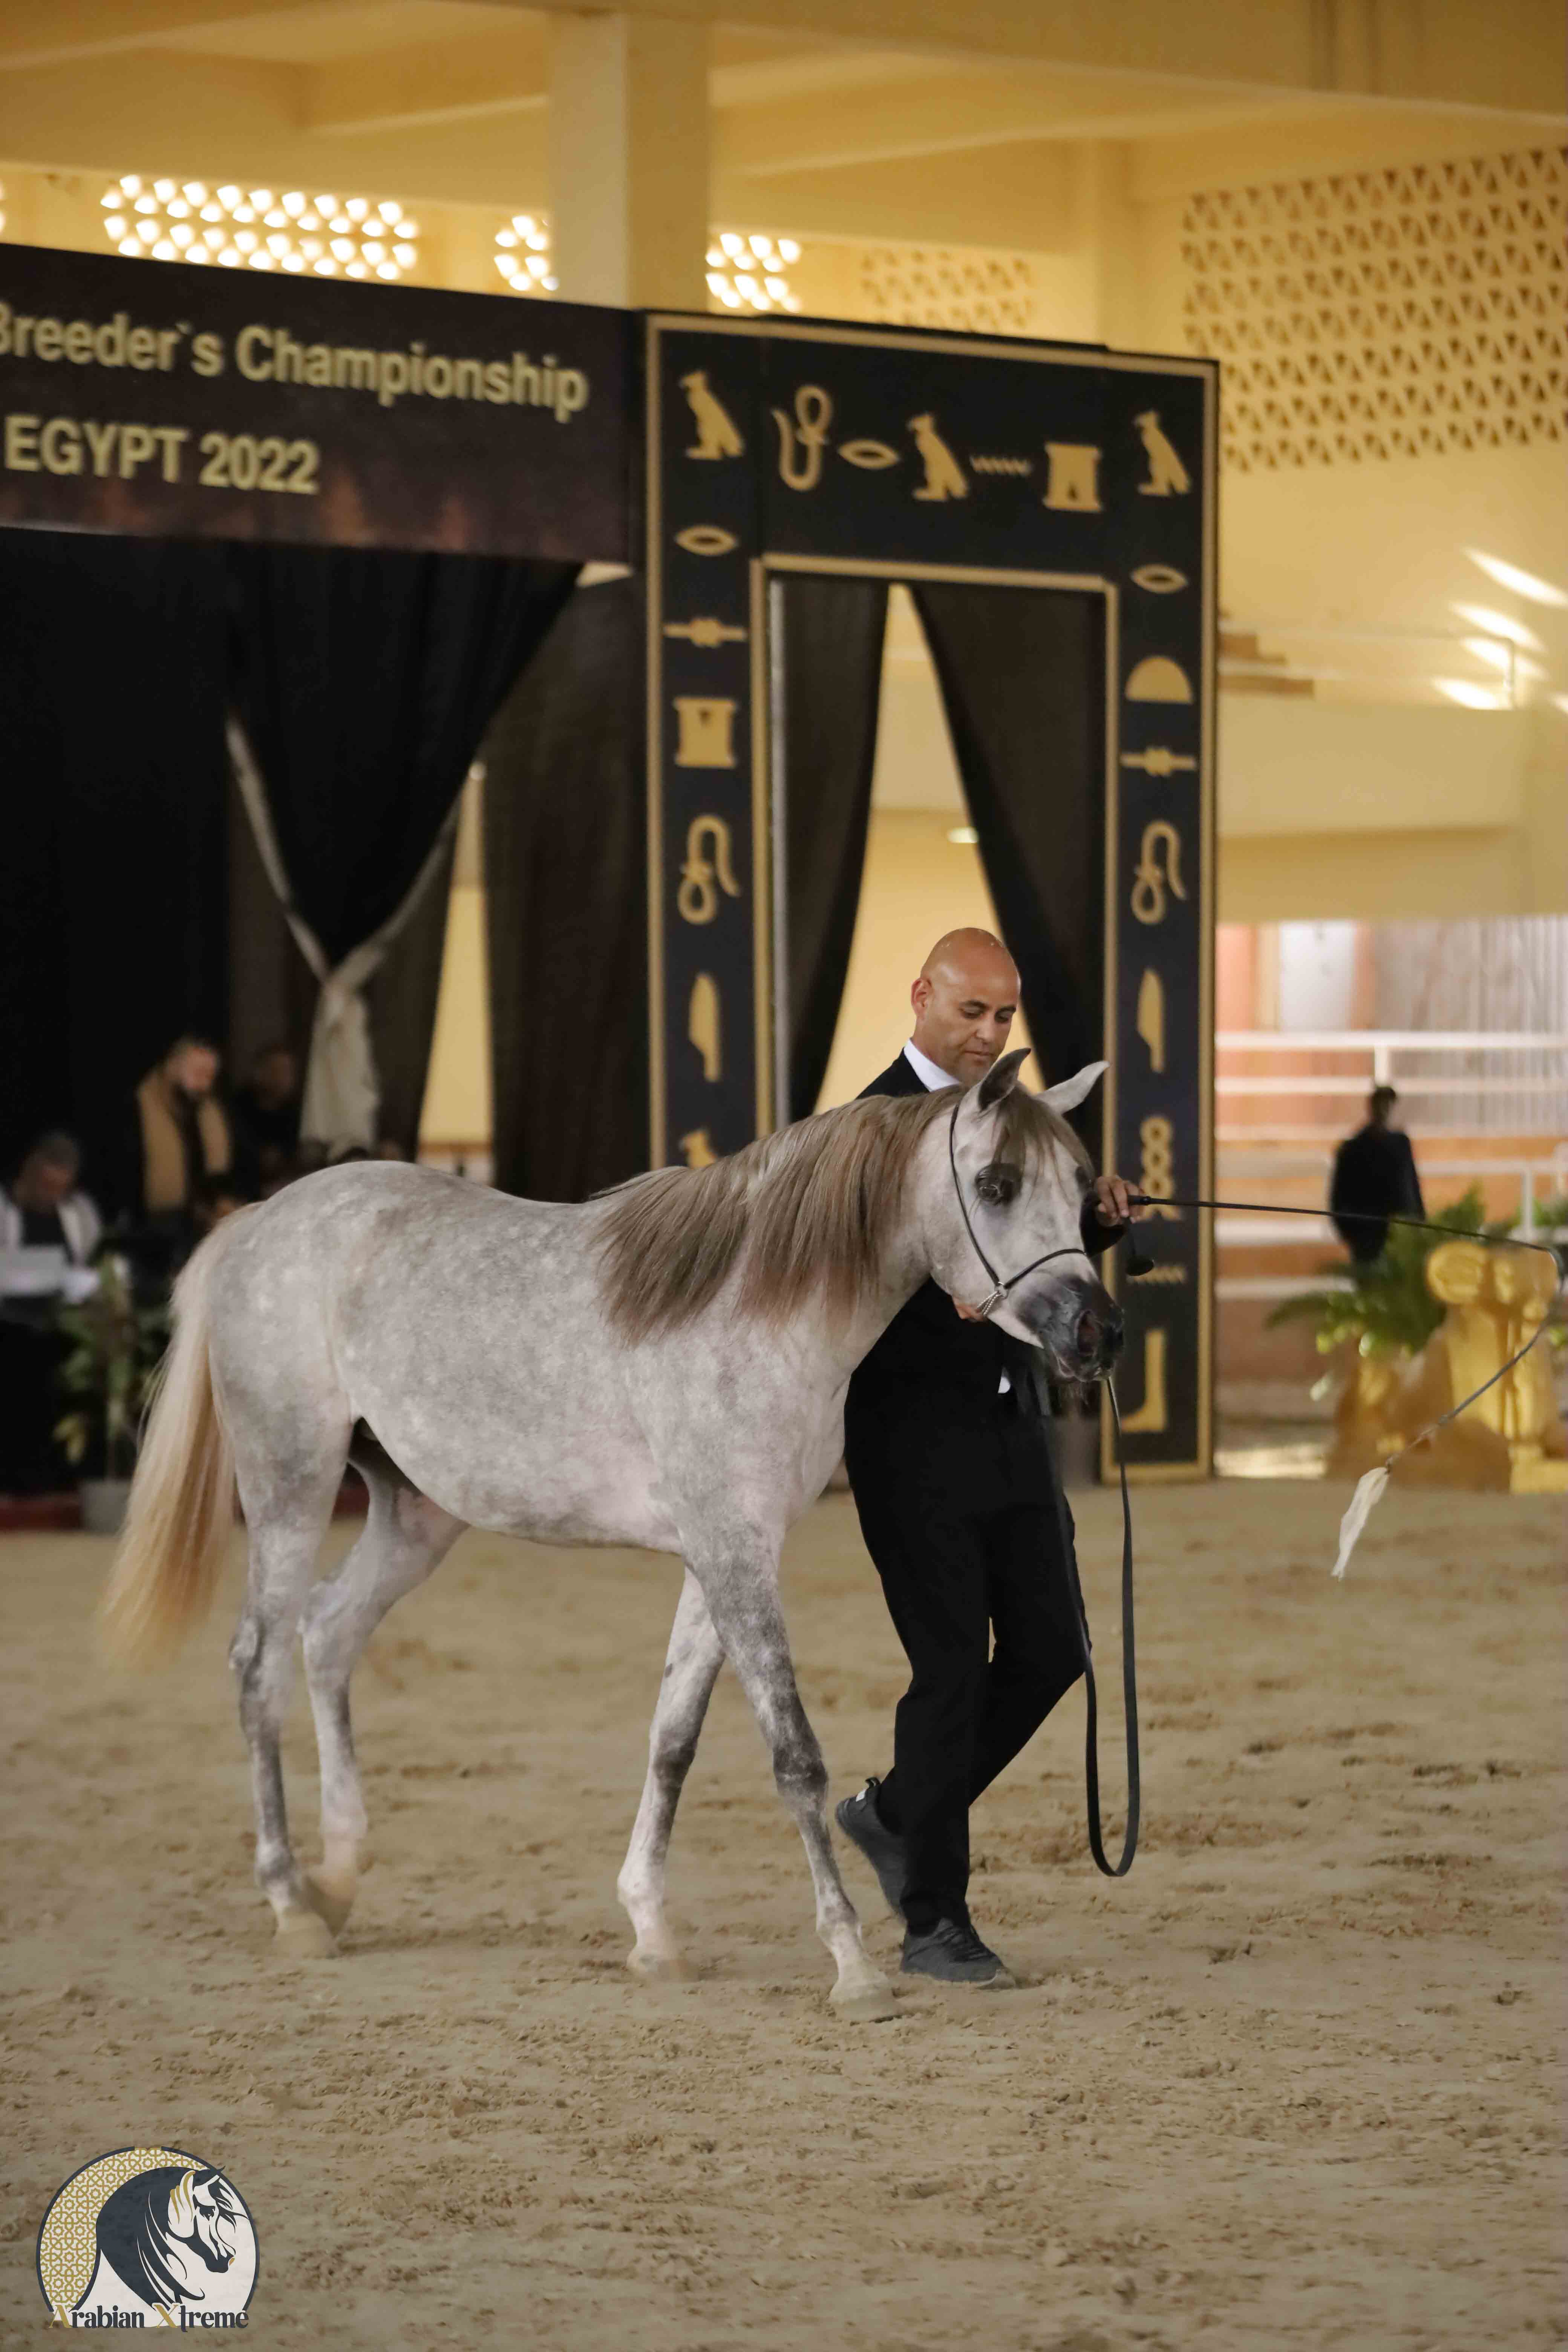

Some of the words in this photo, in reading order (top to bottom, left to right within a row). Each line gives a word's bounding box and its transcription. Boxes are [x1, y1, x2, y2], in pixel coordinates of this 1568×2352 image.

[236, 325, 588, 423] Championship
[5, 414, 189, 484] EGYPT
[200, 432, 319, 494] 2022
